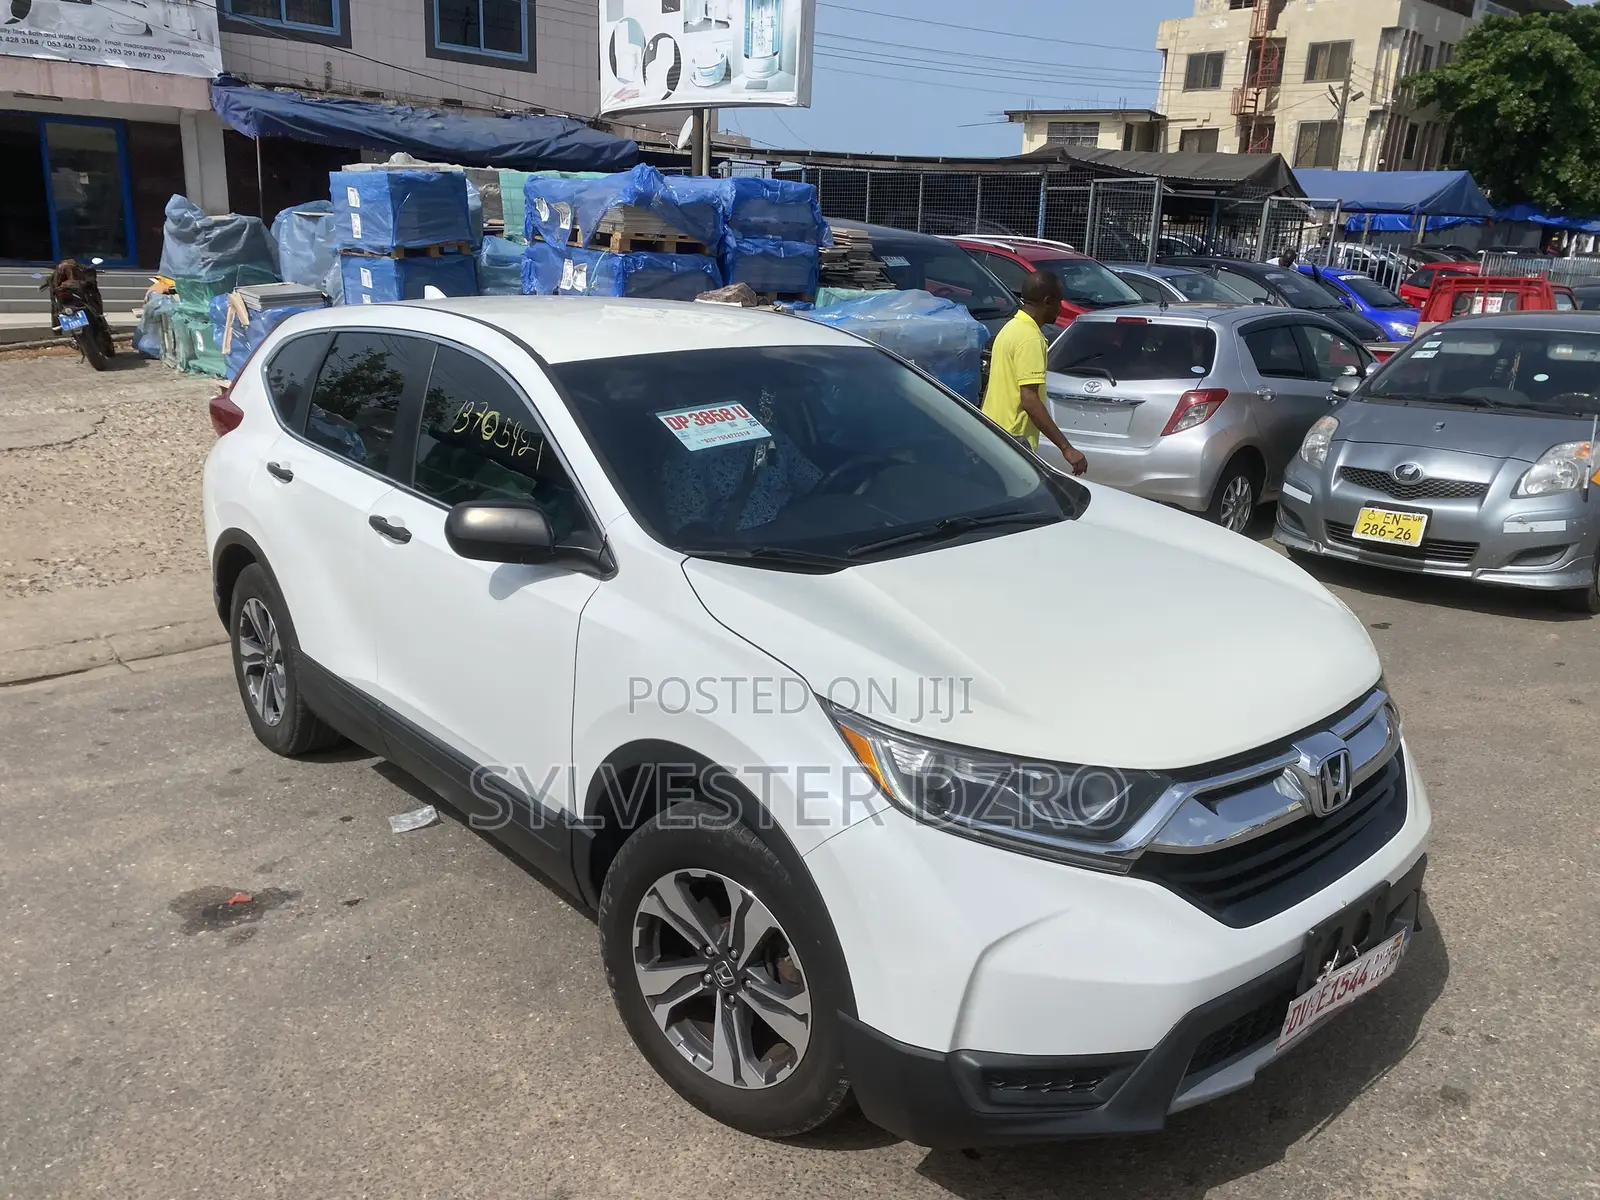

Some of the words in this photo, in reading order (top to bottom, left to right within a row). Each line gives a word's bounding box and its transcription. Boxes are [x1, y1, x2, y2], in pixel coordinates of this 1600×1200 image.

[21, 37, 39, 45] 3184
[664, 415, 690, 431] DP
[687, 407, 737, 426] 3858
[730, 405, 750, 419] U
[1383, 512, 1402, 526] EN
[1361, 522, 1412, 541] 286-26
